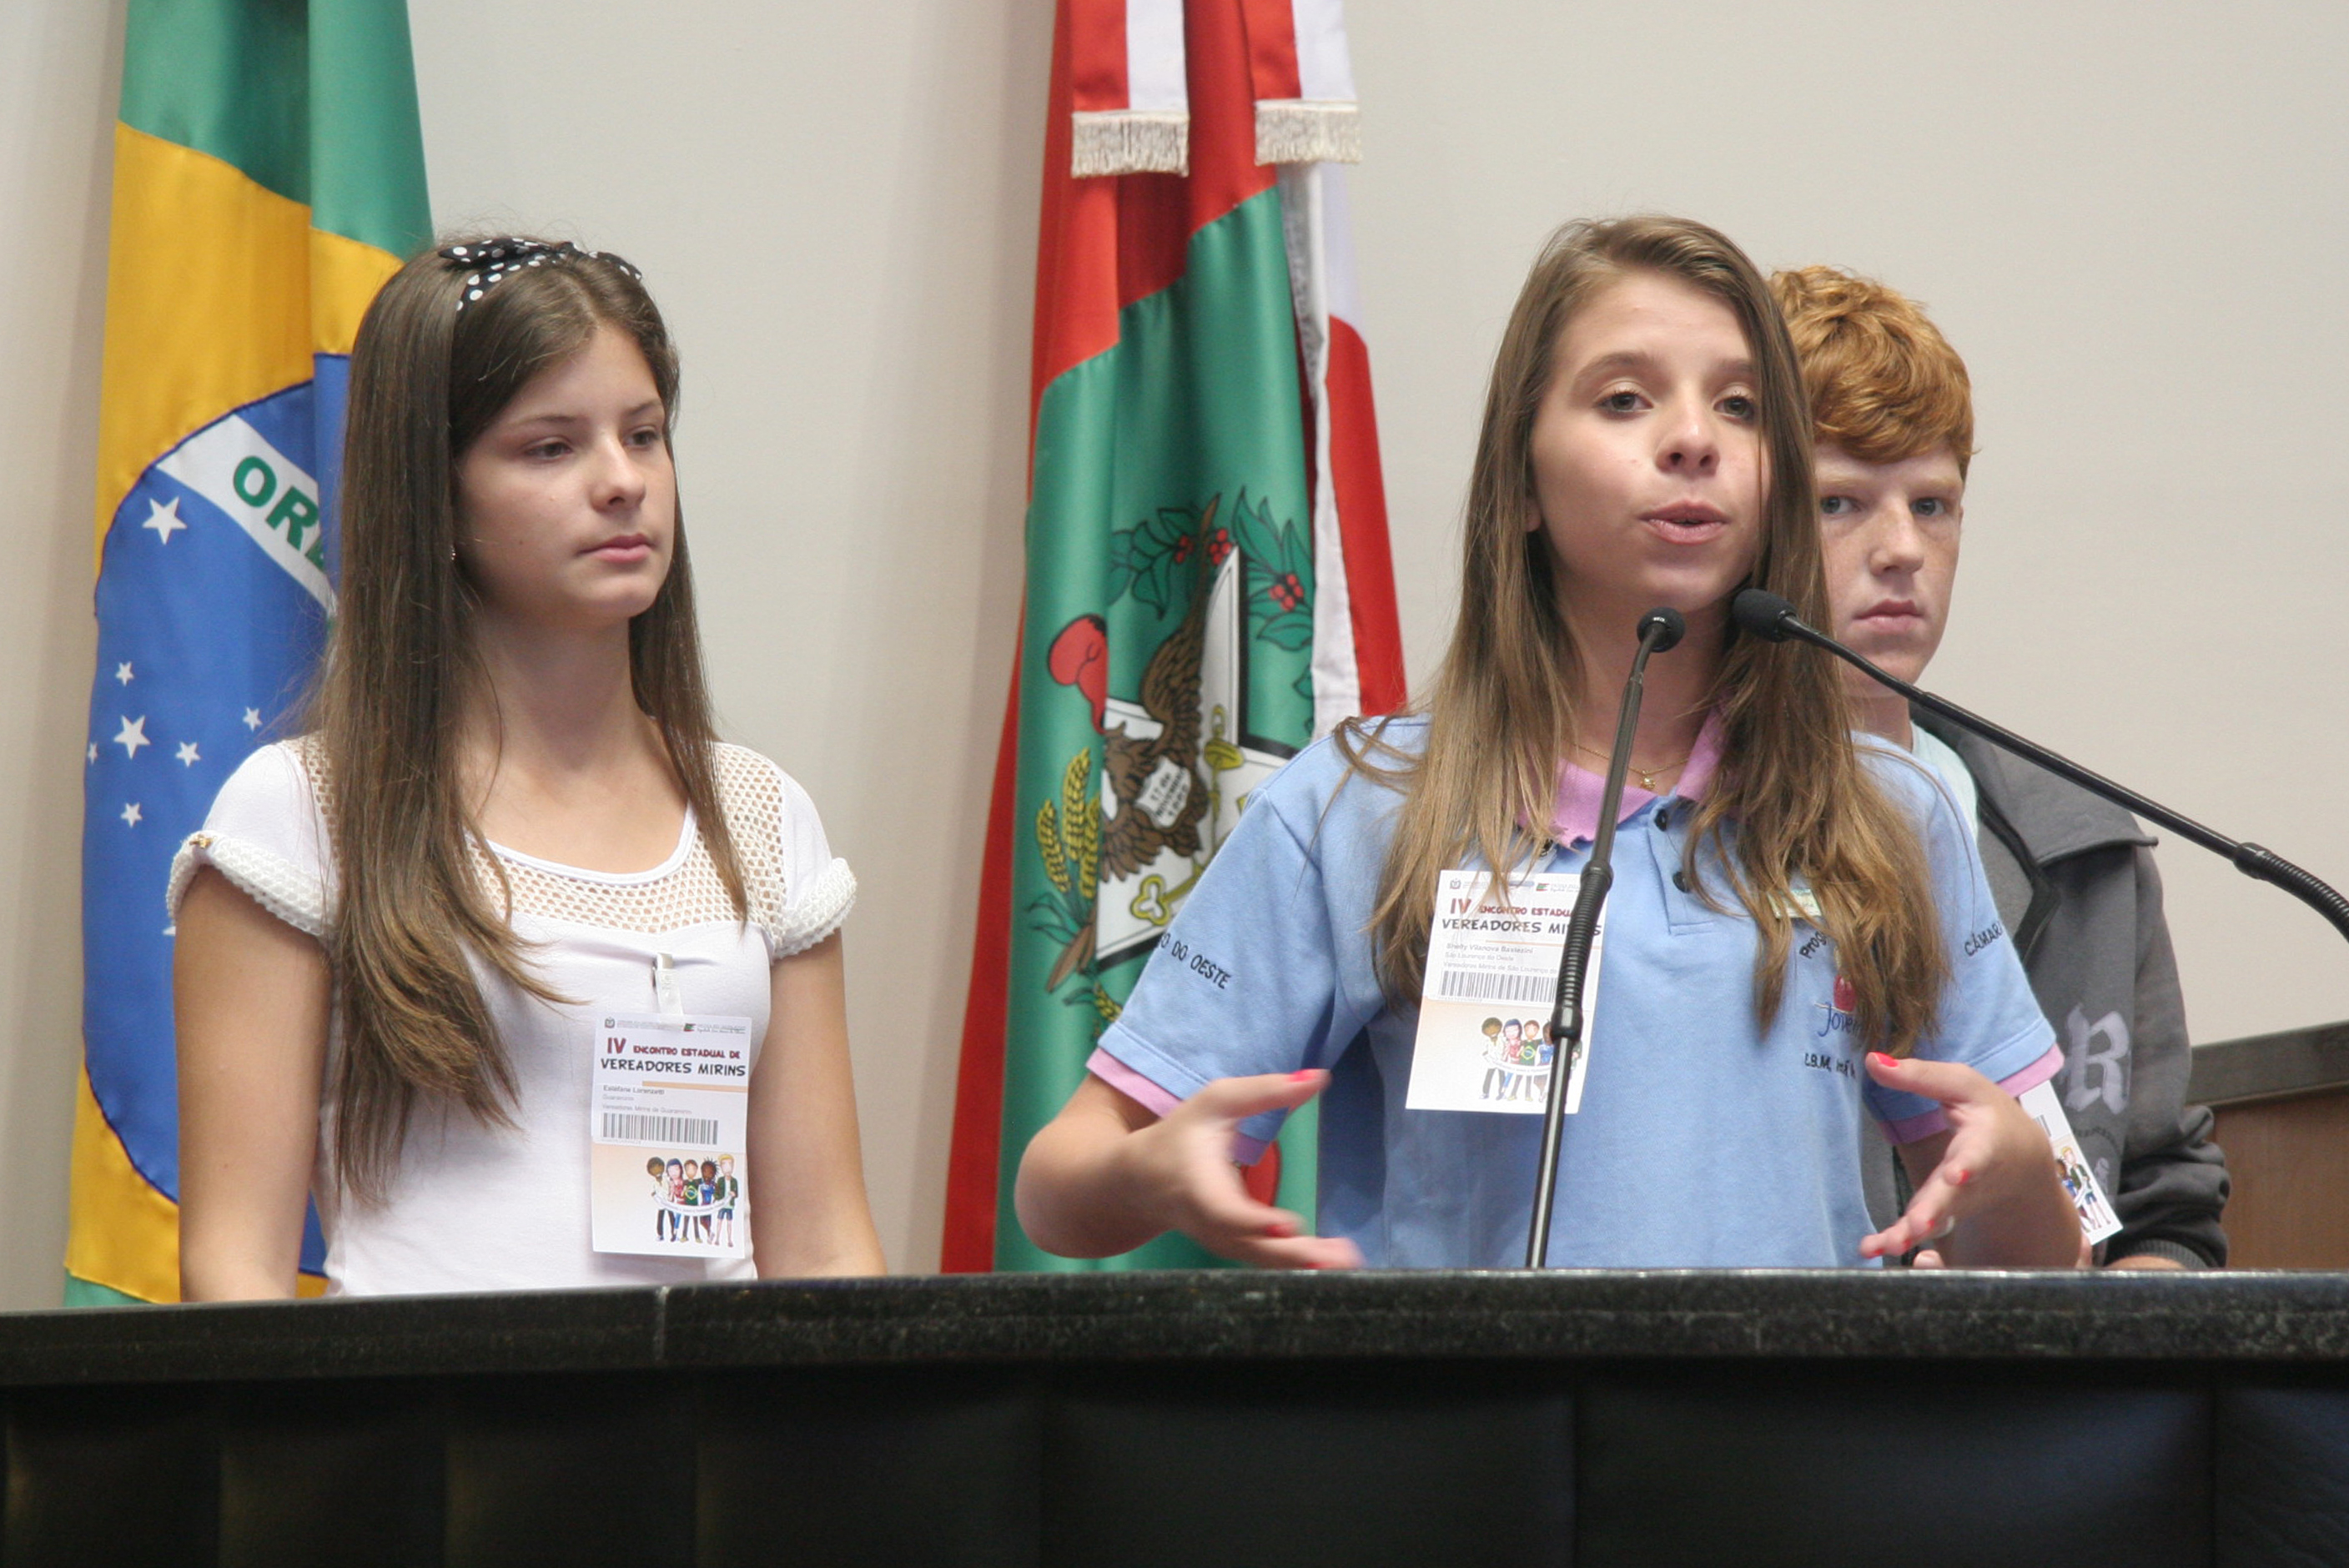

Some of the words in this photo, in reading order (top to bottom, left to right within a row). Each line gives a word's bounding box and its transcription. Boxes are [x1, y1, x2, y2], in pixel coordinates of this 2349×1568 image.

[1450, 897, 1472, 915] IV
[1531, 907, 1572, 917] ESTADU
[1442, 918, 1542, 933] VEREADORES
[1171, 940, 1189, 962] DO
[1190, 954, 1232, 990] OESTE
[607, 1037, 627, 1054] IV
[633, 1044, 678, 1056] ENCONTRO
[681, 1048, 726, 1058] ESTADUAL
[729, 1050, 741, 1059] DE
[601, 1058, 692, 1073] VEREADORES
[697, 1063, 747, 1077] MIRINS
